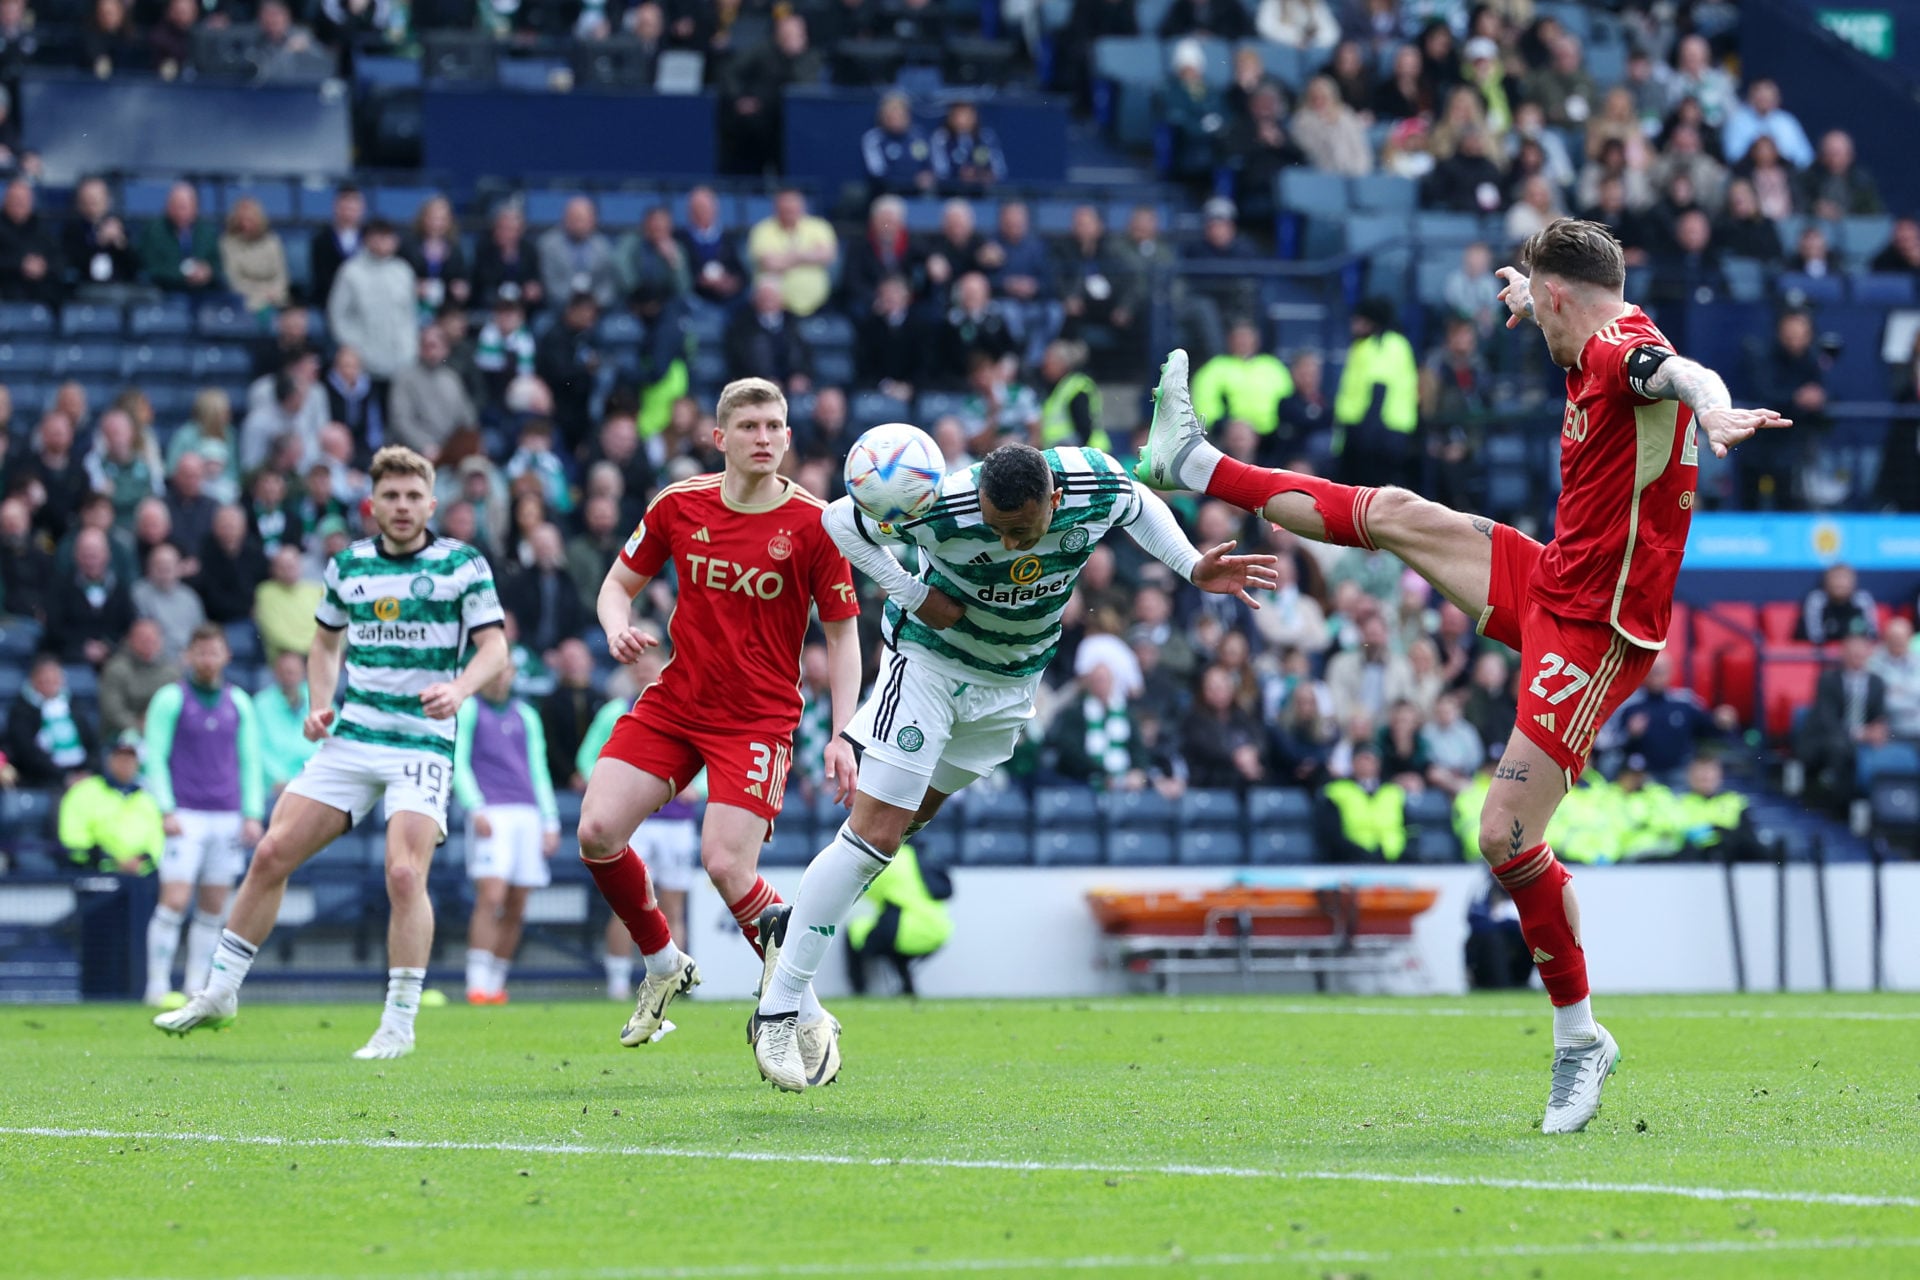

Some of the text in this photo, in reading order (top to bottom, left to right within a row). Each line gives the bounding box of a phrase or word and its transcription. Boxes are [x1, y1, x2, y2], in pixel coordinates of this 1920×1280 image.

[686, 553, 784, 600] TEXO
[977, 574, 1070, 606] dafabet
[357, 624, 427, 642] dafabet
[1528, 652, 1590, 706] 27
[403, 761, 442, 792] 49
[746, 742, 771, 782] 3
